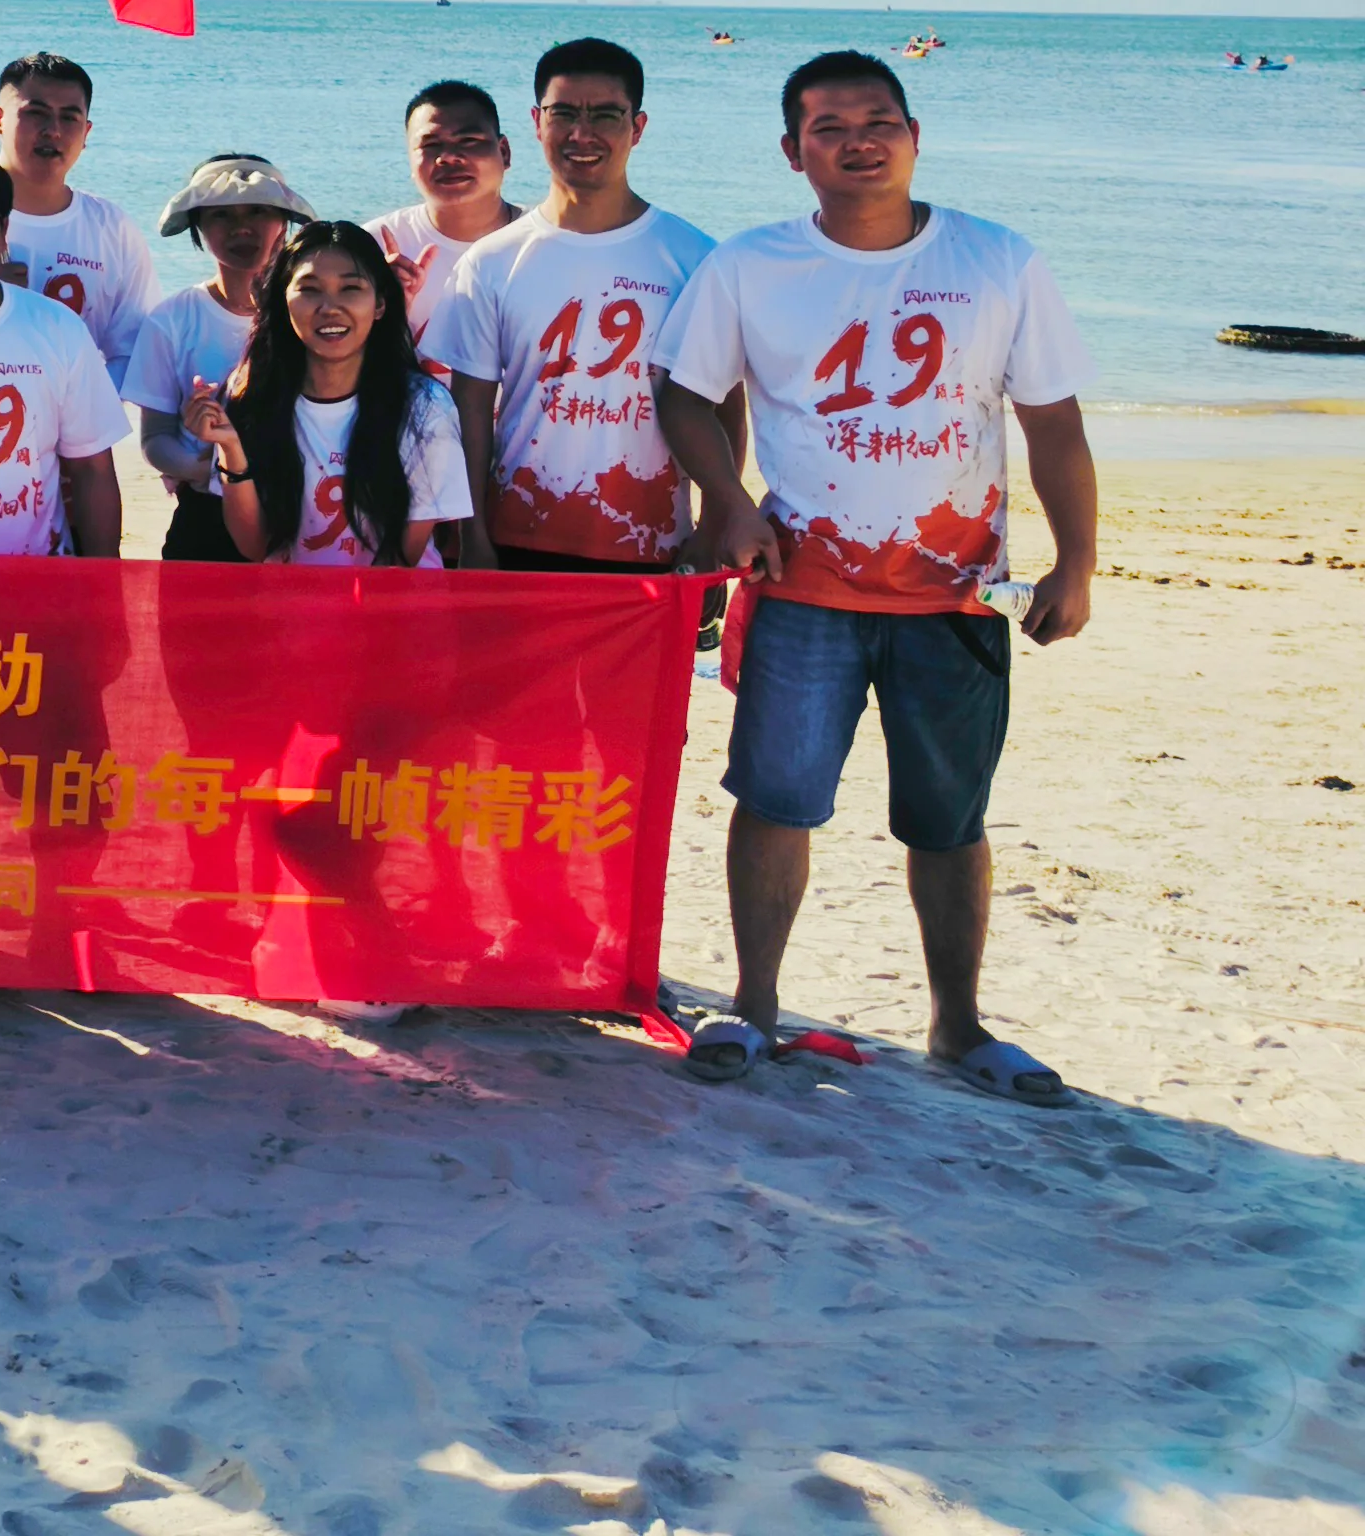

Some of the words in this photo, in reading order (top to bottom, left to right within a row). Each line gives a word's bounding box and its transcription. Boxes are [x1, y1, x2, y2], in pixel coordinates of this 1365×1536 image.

[539, 297, 644, 383] 19
[814, 312, 947, 416] 19
[539, 384, 653, 431] 深耕细作
[826, 416, 970, 467] 深耕细作
[301, 475, 351, 552] 9
